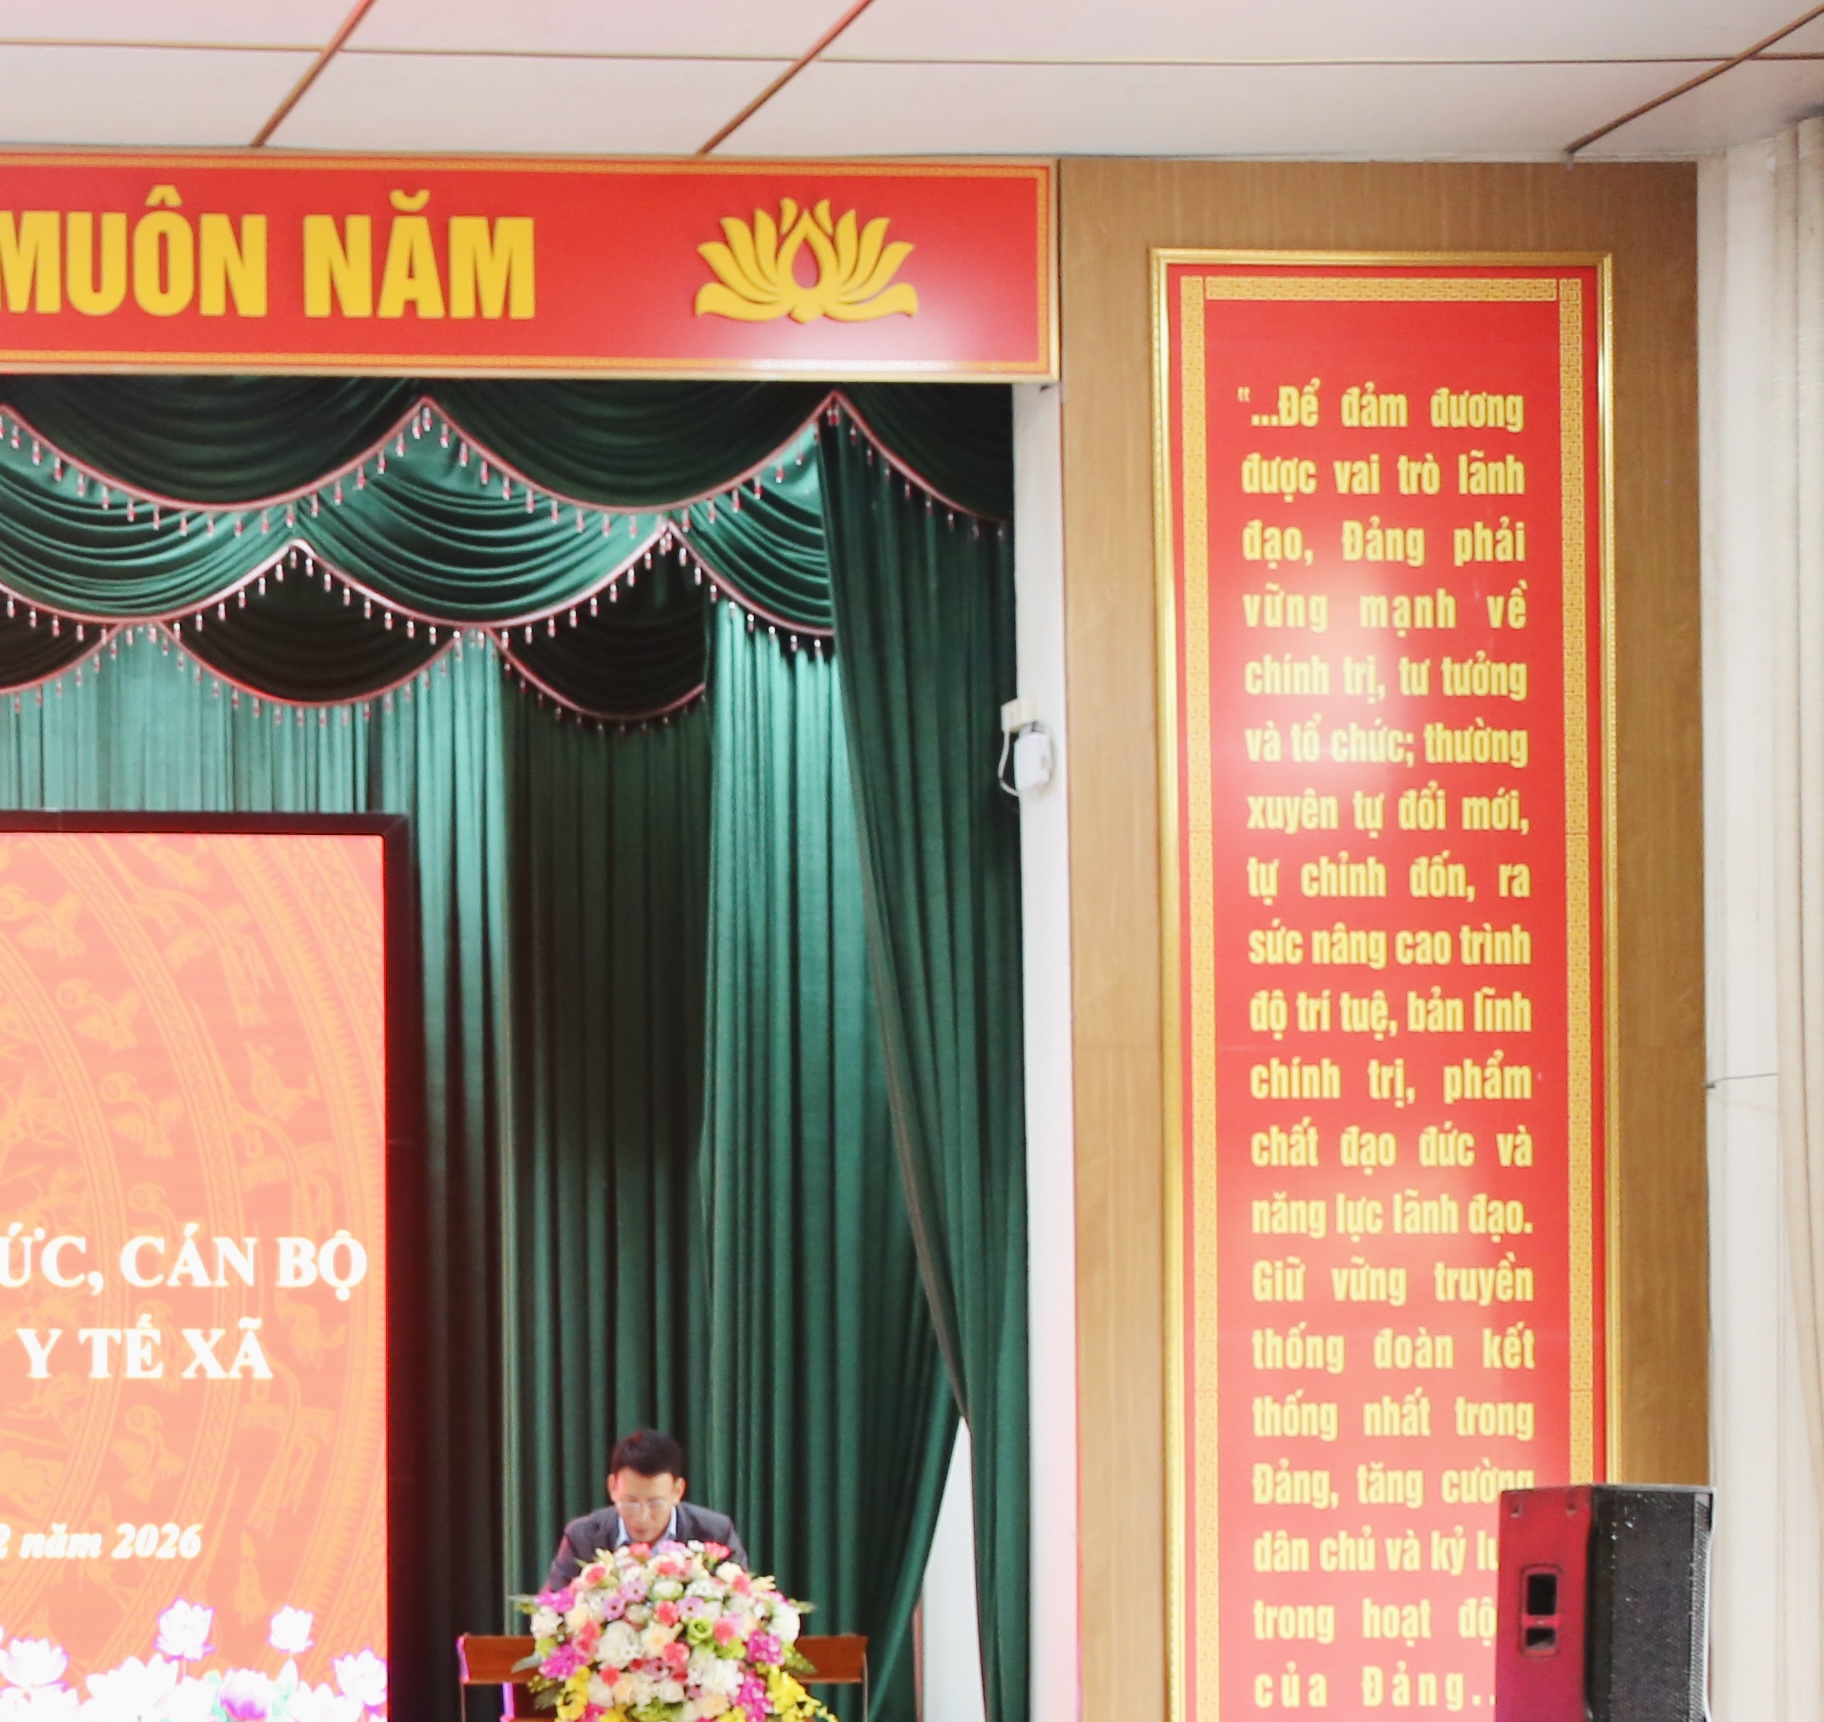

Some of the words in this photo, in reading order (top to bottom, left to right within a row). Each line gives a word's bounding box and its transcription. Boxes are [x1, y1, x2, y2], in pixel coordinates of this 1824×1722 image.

[305, 191, 535, 319] NĂM
[1341, 382, 1409, 426] đảm
[1430, 388, 1525, 432] đương
[1242, 453, 1318, 501] được
[1334, 454, 1382, 494] vai
[1399, 453, 1442, 494] trò
[1459, 450, 1526, 494] lãnh
[1243, 520, 1315, 567] đạo,
[1343, 516, 1426, 566] Đảng
[1454, 517, 1527, 566] phải
[1248, 789, 1340, 833] xuyên
[1354, 793, 1385, 837] tự
[1399, 782, 1448, 829] đổi
[1462, 790, 1530, 832] mới,
[1248, 857, 1280, 904] tự
[1301, 852, 1388, 896] chỉnh
[1410, 851, 1477, 900] đốn,
[1499, 864, 1532, 897] ra
[1249, 919, 1305, 964] sức
[1312, 923, 1389, 969] nâng
[1396, 930, 1453, 964] cao
[1461, 924, 1532, 964] trình
[1250, 990, 1289, 1039] độ
[1297, 991, 1332, 1031] trí
[1341, 990, 1399, 1039] tuệ,
[1408, 987, 1466, 1032] bản
[1474, 987, 1533, 1031] lĩnh
[1251, 1058, 1343, 1099] chính
[1369, 1059, 1417, 1107] trị,
[1444, 1051, 1534, 1103] phẩm
[1252, 1117, 1321, 1166] chất
[1341, 1126, 1398, 1174] đạo
[1419, 1123, 1476, 1166] đức
[1497, 1126, 1534, 1166] và
[1252, 1193, 1329, 1239] năng
[1337, 1194, 1385, 1241] lực
[1394, 1189, 1461, 1233] lãnh
[1468, 1194, 1534, 1241] đạo.
[120, 1223, 256, 1287] CÁN
[278, 1231, 367, 1300] BỘ
[1253, 1256, 1307, 1301] Giữ
[1332, 1256, 1409, 1307] vững
[1435, 1253, 1535, 1305] truyền
[17, 1329, 61, 1378] Y
[79, 1314, 163, 1378] TẾ
[183, 1317, 272, 1378] XÃ
[1252, 1323, 1347, 1374] thống
[1374, 1328, 1456, 1369] đoàn
[1483, 1323, 1536, 1369] kết
[1253, 1390, 1340, 1441] thống
[1364, 1388, 1432, 1436] nhất
[1456, 1398, 1536, 1441] trong
[20, 1524, 102, 1558] năm
[112, 1523, 201, 1558] 2026
